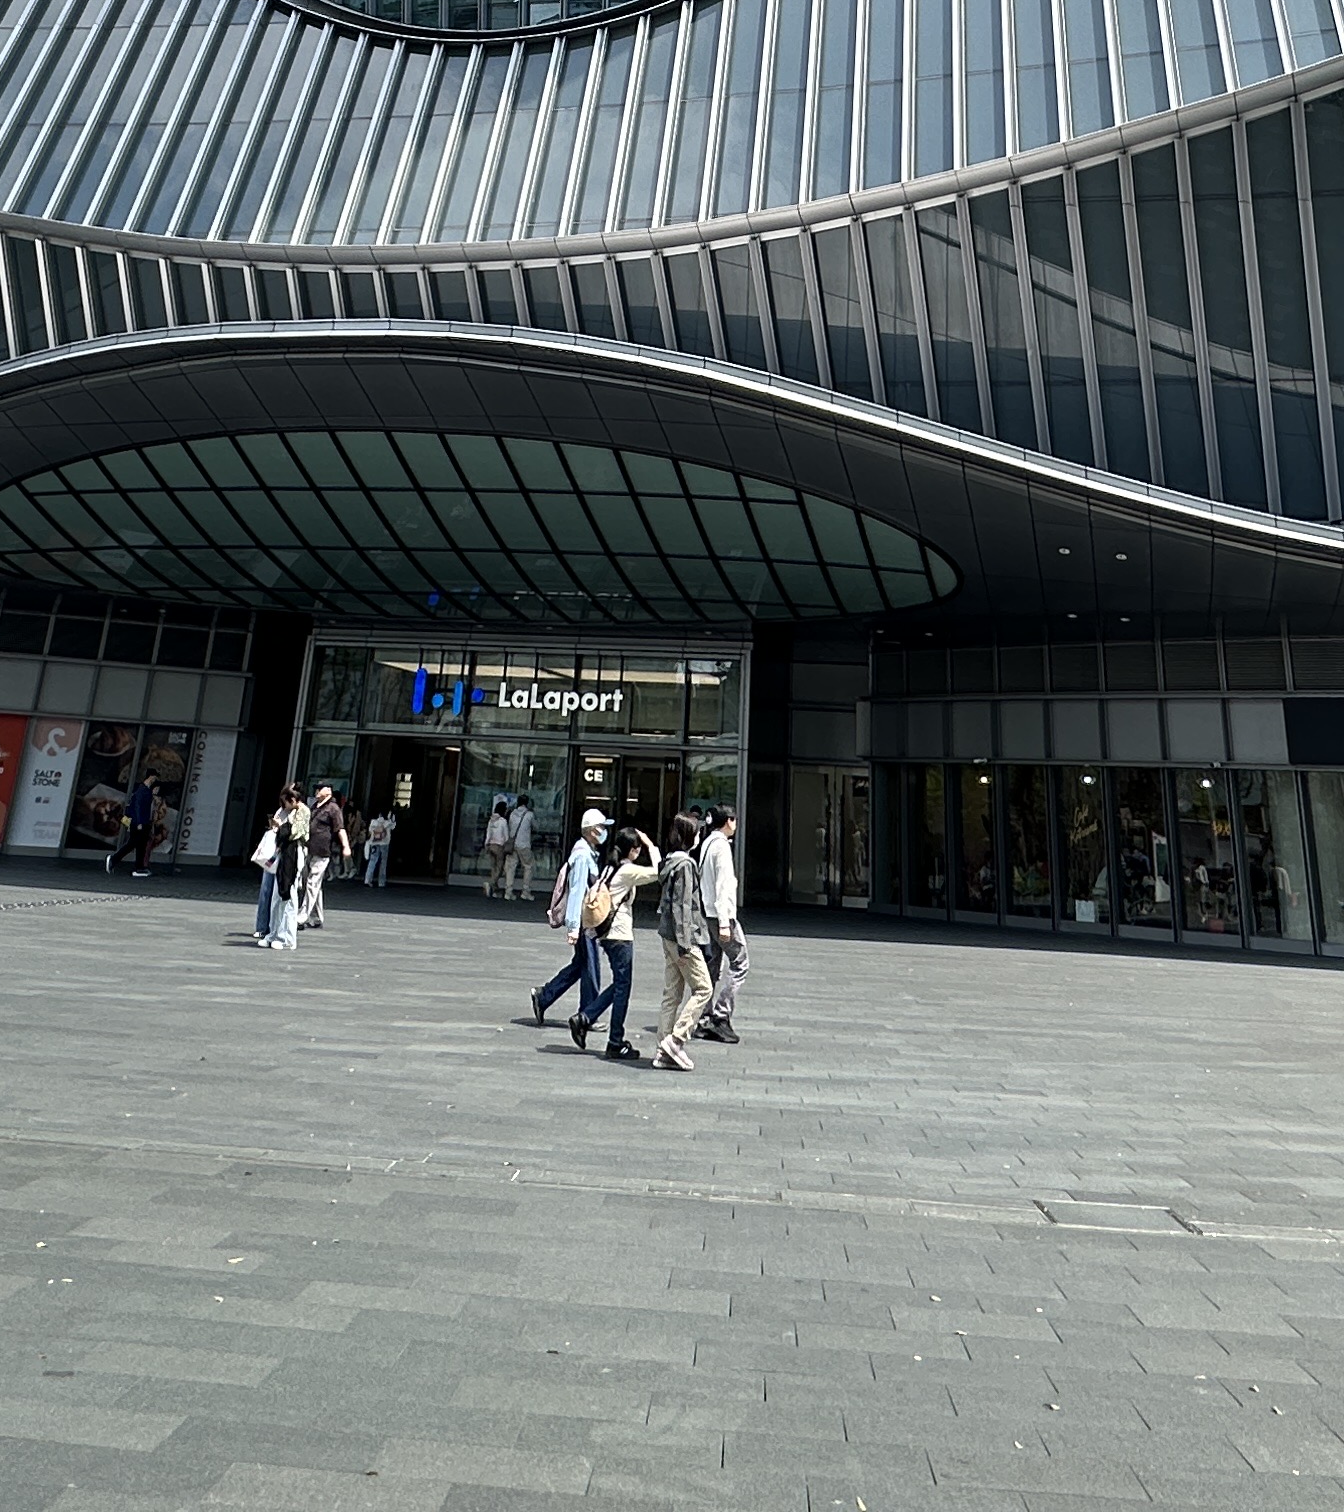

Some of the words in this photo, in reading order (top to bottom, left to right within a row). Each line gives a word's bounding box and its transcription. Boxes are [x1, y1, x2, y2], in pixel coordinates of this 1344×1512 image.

[497, 682, 624, 717] LaLaport
[34, 769, 54, 778] SALT
[190, 731, 208, 795] COMING
[583, 768, 605, 783] CE
[32, 777, 61, 787] STONE
[179, 807, 195, 851] SOON
